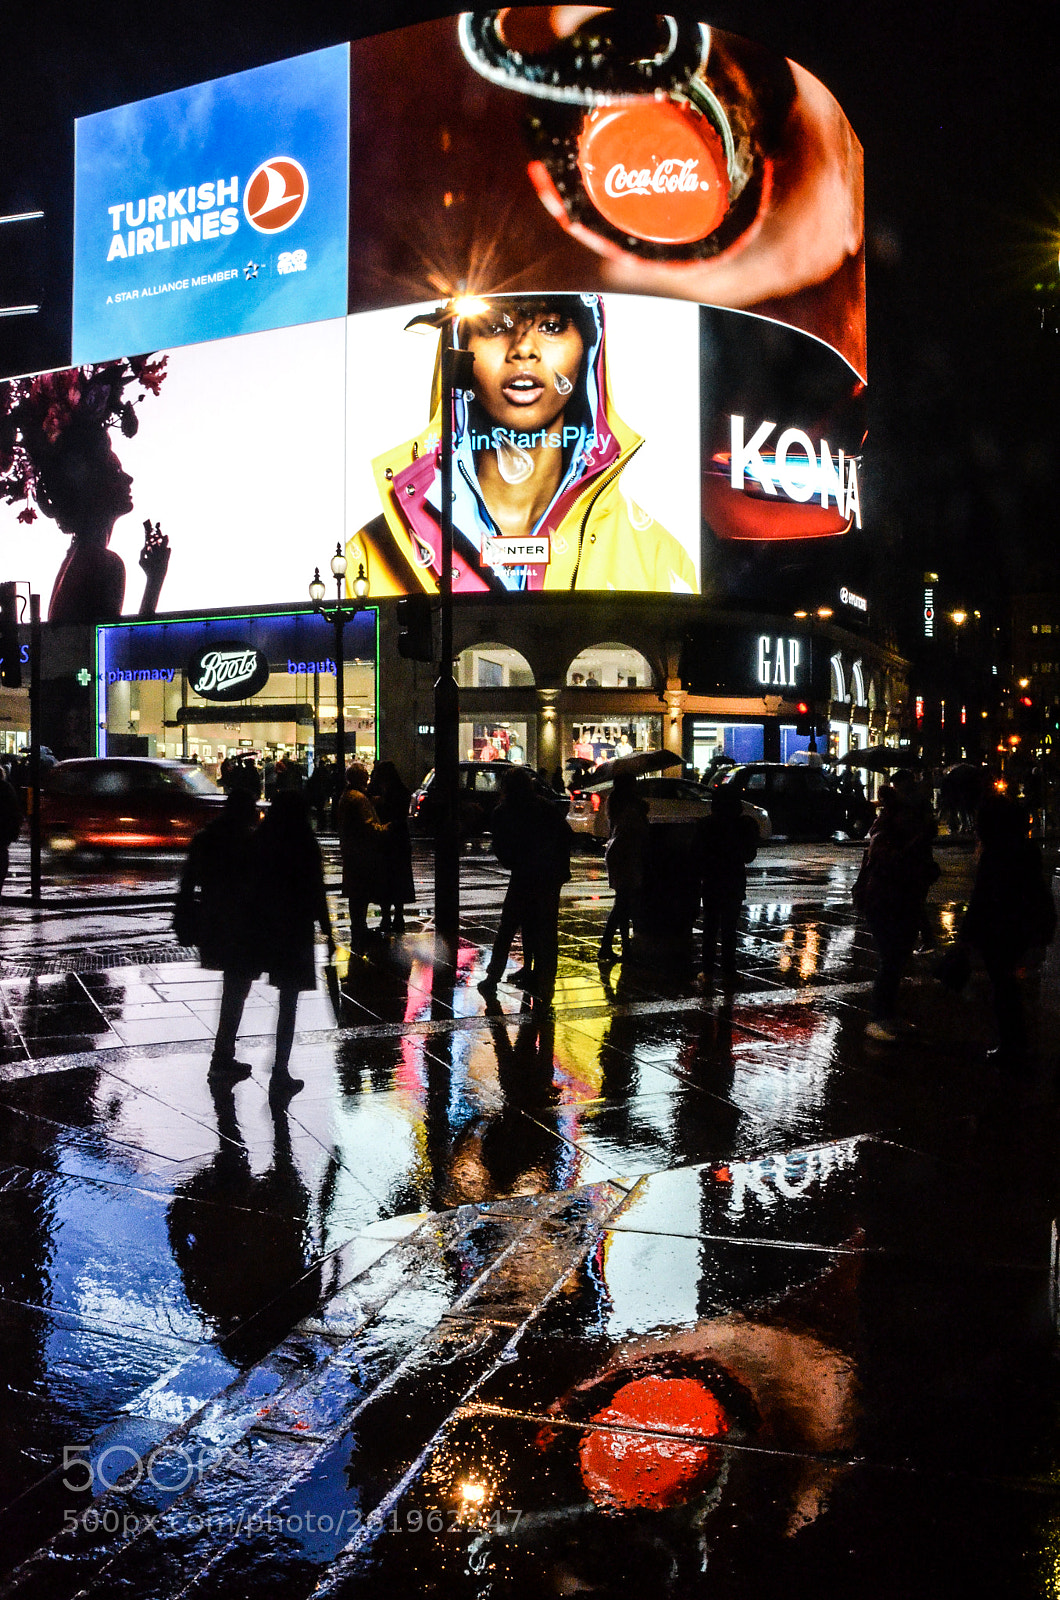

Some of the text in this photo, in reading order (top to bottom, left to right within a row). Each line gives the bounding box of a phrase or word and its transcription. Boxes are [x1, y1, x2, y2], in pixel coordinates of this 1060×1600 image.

[108, 176, 239, 231] TURKISH
[106, 207, 240, 262] AIRLINES
[106, 269, 239, 305] A STAR ALLIANCE MEMBER
[731, 414, 863, 530] KONA
[497, 545, 545, 555] NTER
[108, 667, 175, 684] pharmacy
[194, 649, 258, 692] Boots
[758, 635, 800, 686] GAP
